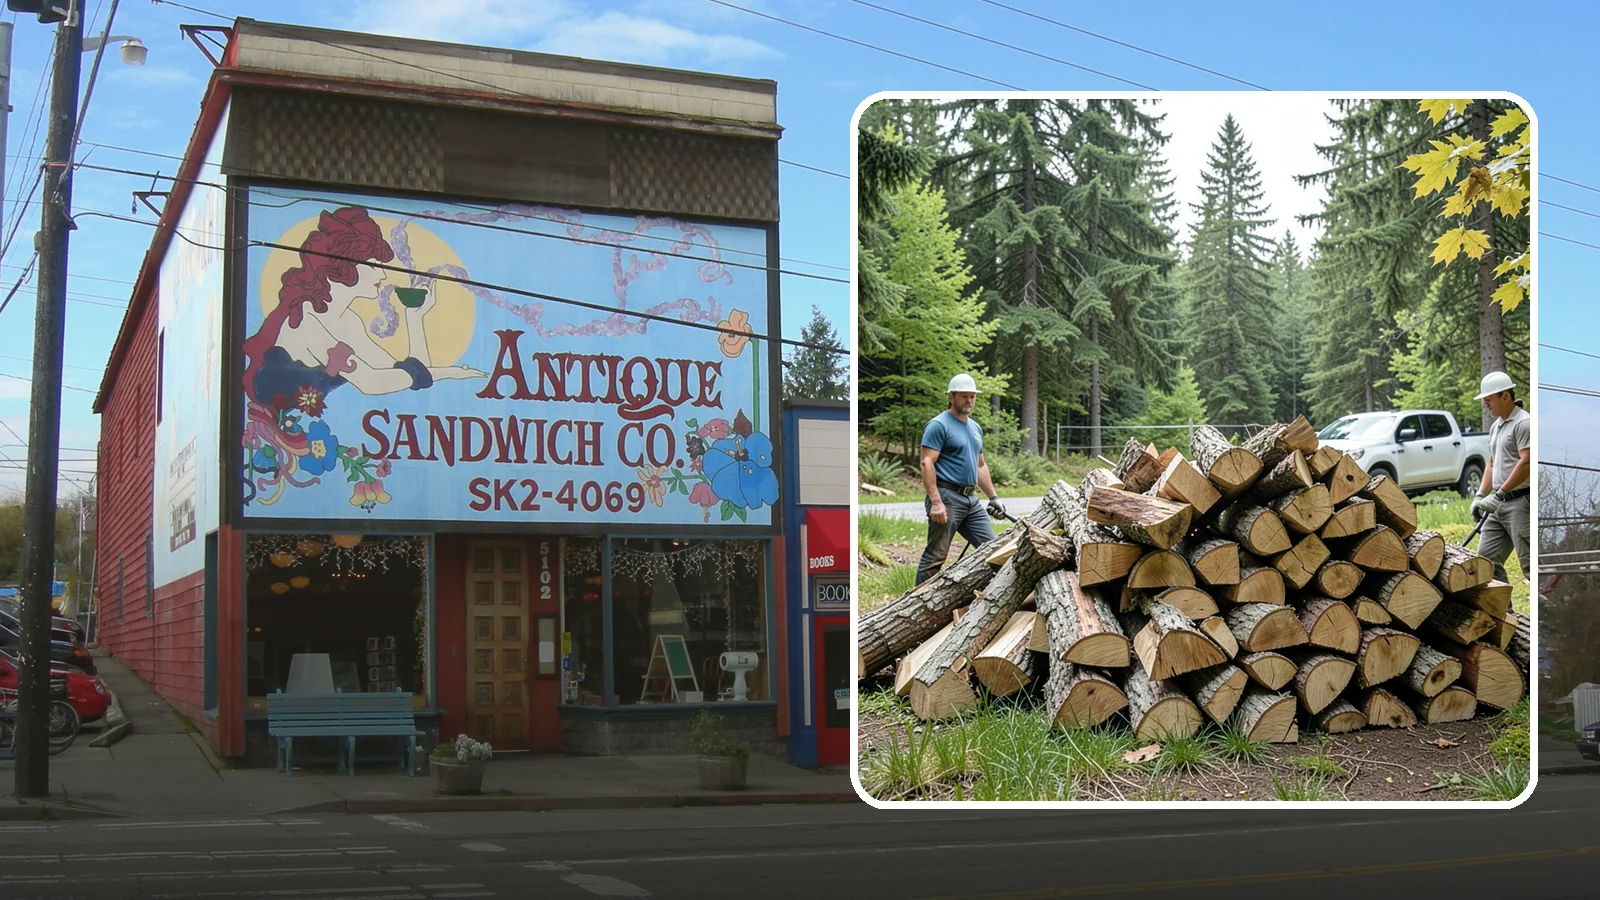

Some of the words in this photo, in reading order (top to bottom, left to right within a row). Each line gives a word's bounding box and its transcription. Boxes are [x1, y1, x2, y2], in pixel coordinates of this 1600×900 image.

[476, 328, 724, 421] ANTIQUE
[361, 407, 605, 467] SANDWICH
[616, 421, 685, 469] CO.
[468, 477, 646, 513] SK2-4069
[539, 541, 552, 600] 5102
[809, 554, 835, 569] BOOKS
